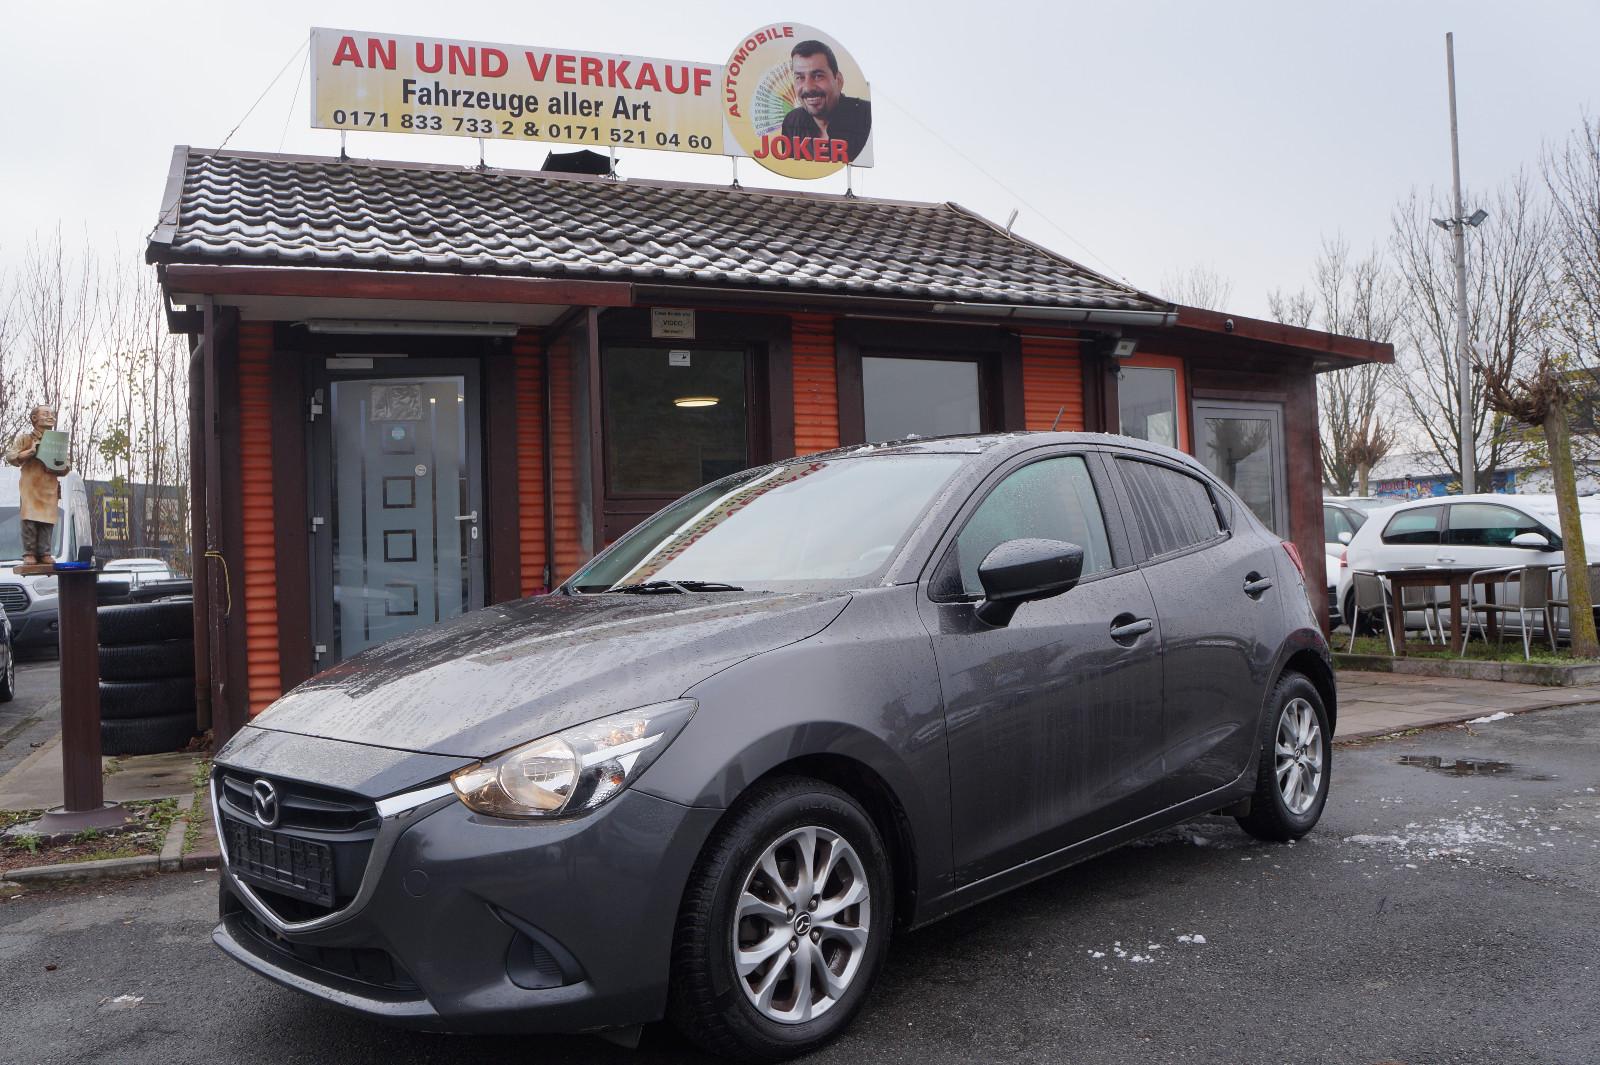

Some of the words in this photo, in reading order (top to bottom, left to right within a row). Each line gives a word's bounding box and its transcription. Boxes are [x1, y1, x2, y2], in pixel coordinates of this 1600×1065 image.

[332, 36, 397, 70] AN
[415, 42, 509, 78] UND
[525, 51, 712, 96] VERKAUF
[725, 26, 794, 118] AUTOMOBILE
[402, 78, 539, 118] Fahrzeuge
[548, 91, 603, 117] aller
[612, 95, 652, 121] Art
[333, 109, 389, 127] 0171
[400, 113, 443, 130] 833
[452, 117, 493, 133] 733
[501, 120, 514, 135] 2
[523, 121, 539, 136] &
[548, 123, 599, 141] 0171
[610, 128, 646, 144] 521
[655, 131, 680, 147] 04
[688, 134, 712, 149] 60
[753, 135, 849, 164] JOKER
